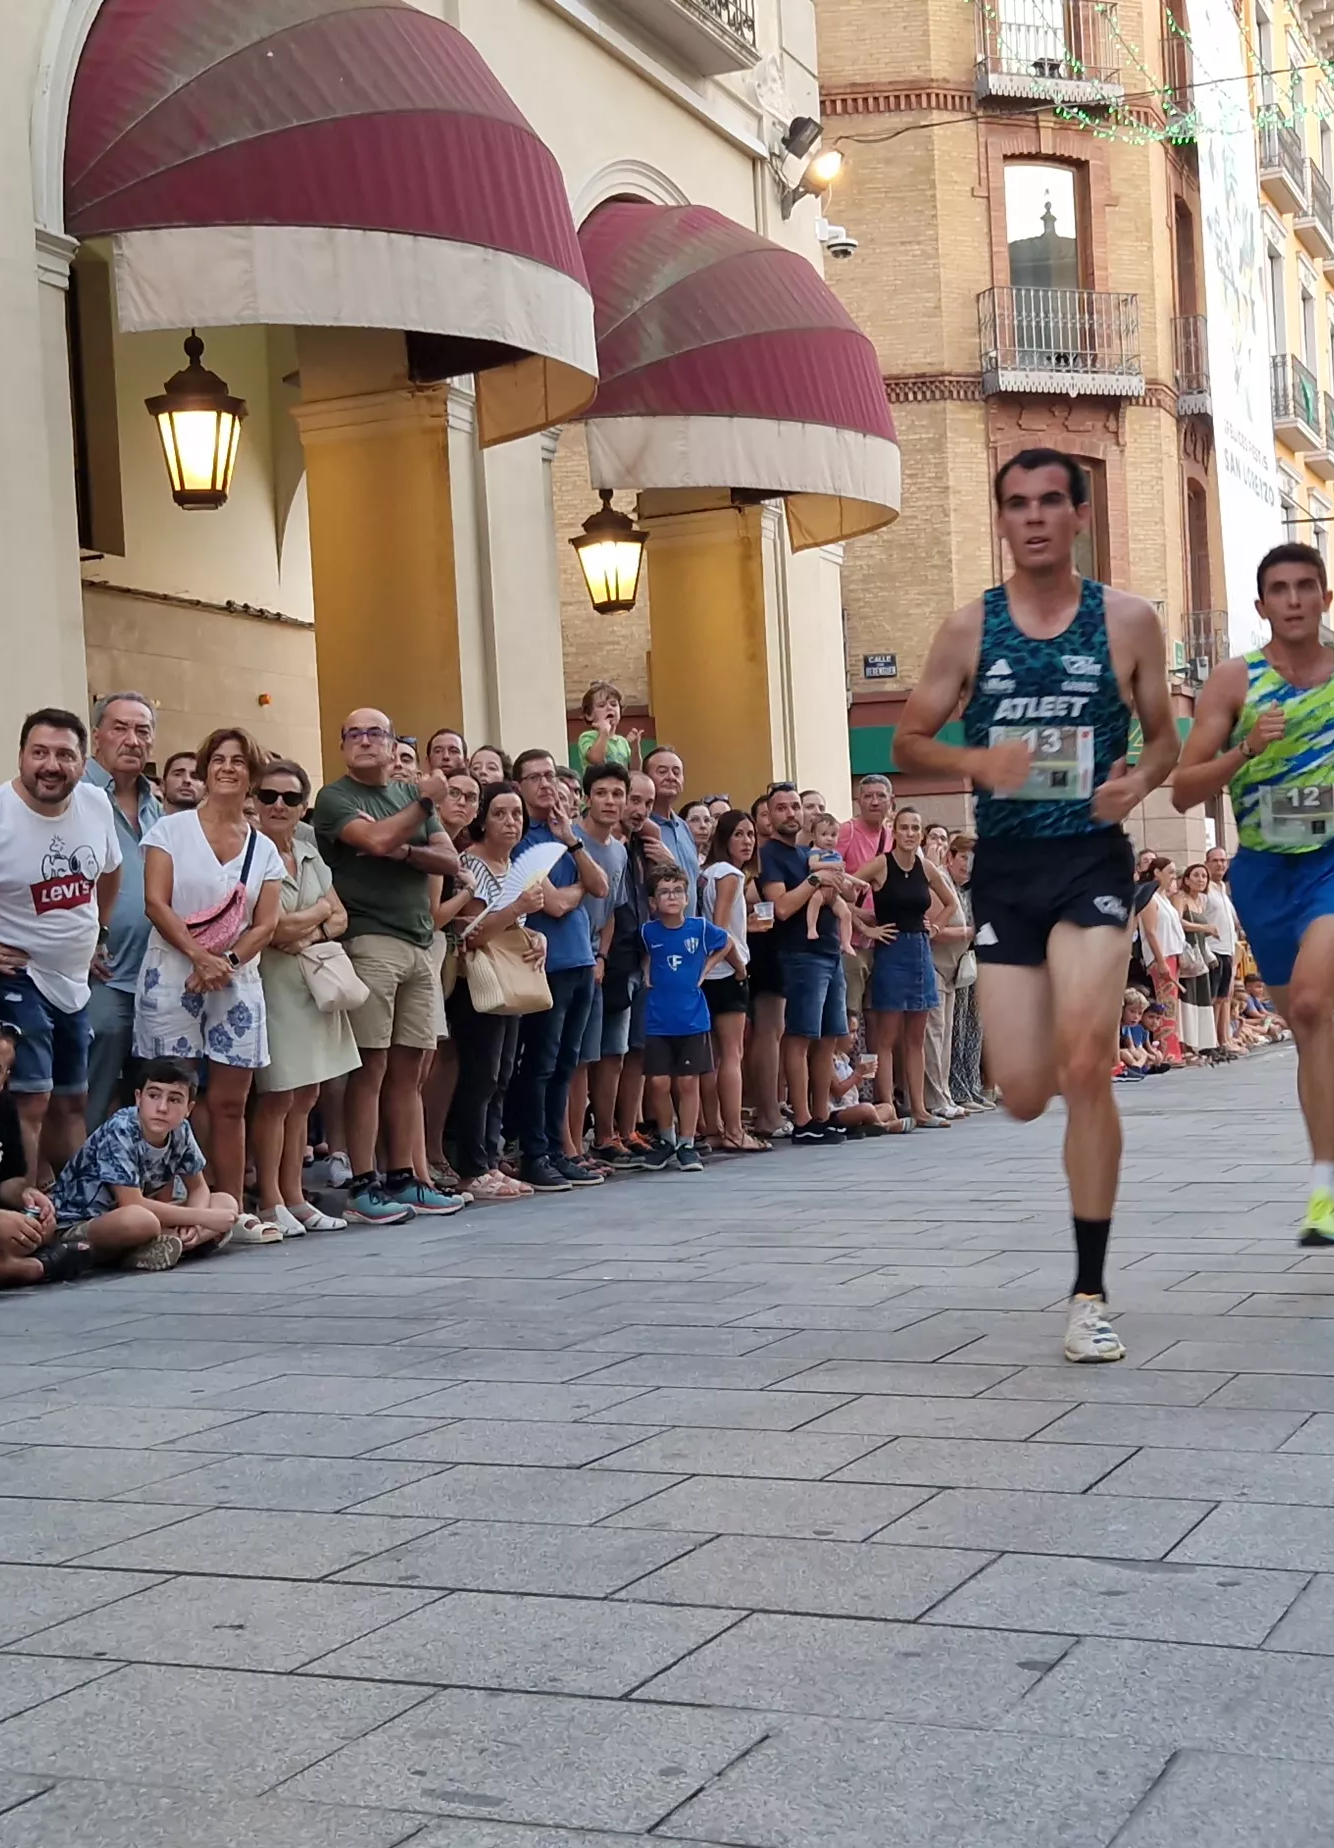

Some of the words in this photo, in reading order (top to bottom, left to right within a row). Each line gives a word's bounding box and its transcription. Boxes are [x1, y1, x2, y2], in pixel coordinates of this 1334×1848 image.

[1224, 448, 1241, 479] SAN
[1243, 462, 1274, 507] LORENZO
[868, 655, 892, 663] CALLE
[994, 696, 1090, 721] ATLEET
[1021, 728, 1063, 753] 13
[1286, 786, 1321, 807] 12
